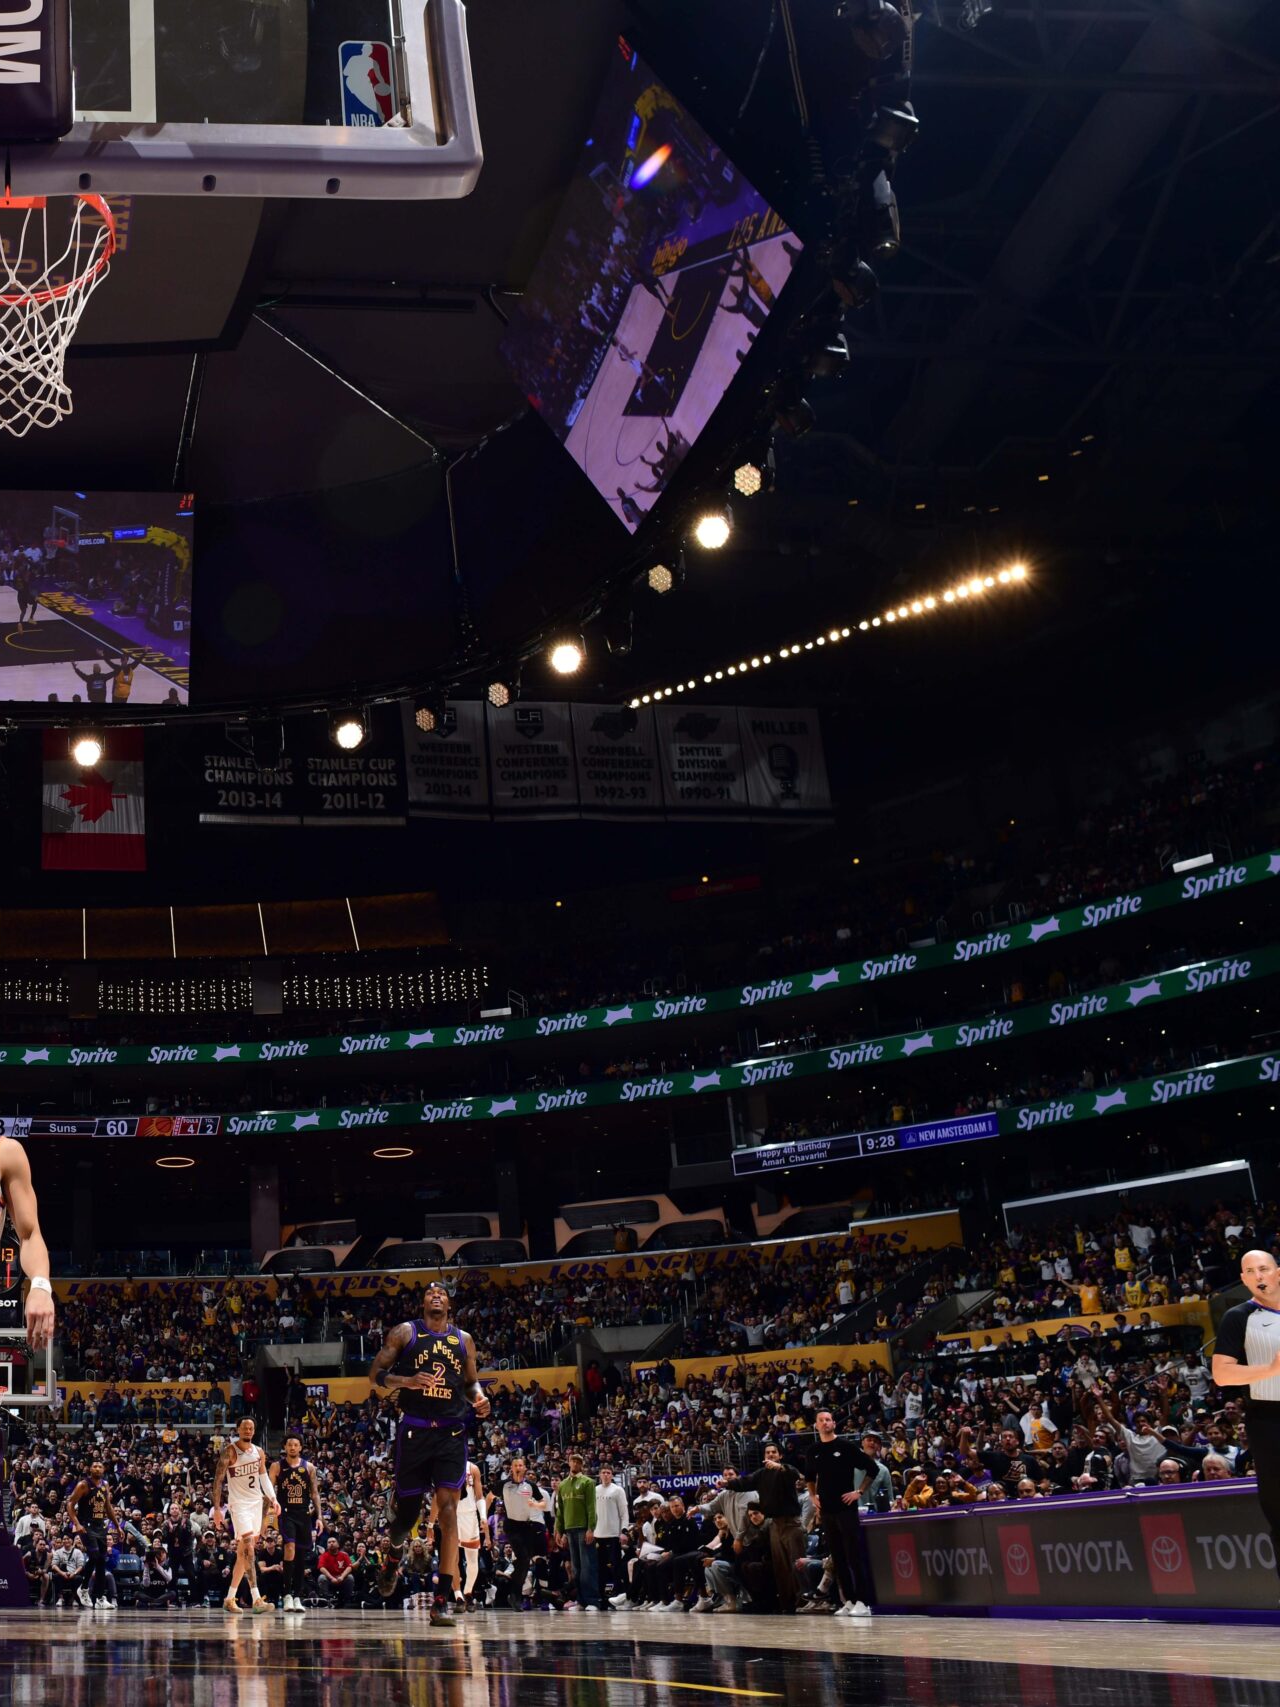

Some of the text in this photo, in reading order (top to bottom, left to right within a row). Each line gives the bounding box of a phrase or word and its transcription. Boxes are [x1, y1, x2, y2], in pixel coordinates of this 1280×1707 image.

[350, 113, 376, 127] NBA
[751, 720, 808, 735] MILLER
[417, 743, 471, 754] WESTERN
[504, 744, 559, 754] WESTERN
[679, 747, 722, 757] SMYTHE
[307, 758, 396, 771] STANLEY CUP
[411, 755, 481, 768] CONFERENCE
[496, 756, 569, 768] CONFERENCE
[583, 758, 654, 769] CONFERENCE
[678, 759, 727, 769] DIVISION
[204, 769, 294, 785] CHAMPIONS
[308, 773, 398, 787] CHAMPIONS
[415, 768, 479, 780] CHAMPIONS
[501, 769, 567, 781] CHAMPIONS
[587, 770, 652, 781] CHAMPIONS
[672, 771, 736, 782] CHAMPIONS
[425, 782, 471, 797] 2013-14
[512, 785, 560, 799] 2011-12
[595, 786, 647, 799] 1992-93
[680, 786, 731, 799] 1990-91
[217, 789, 283, 808] 2013-14
[322, 793, 386, 809] 2011-12
[1183, 867, 1246, 898] Sprite
[1083, 896, 1141, 926] Sprite
[954, 933, 1010, 961] Sprite
[861, 954, 916, 980] Sprite
[1186, 960, 1251, 992] Sprite
[741, 980, 792, 1005] Sprite
[653, 996, 706, 1019] Sprite
[1050, 995, 1107, 1025] Sprite
[536, 1013, 587, 1035] Sprite
[454, 1025, 504, 1045] Sprite
[956, 1019, 1013, 1046] Sprite
[259, 1041, 308, 1060] Sprite
[340, 1034, 390, 1054] Sprite
[68, 1048, 117, 1066] Sprite
[148, 1046, 197, 1064] Sprite
[828, 1043, 883, 1069] Sprite
[741, 1060, 794, 1085] Sprite
[620, 1079, 673, 1101] Sprite
[1151, 1073, 1215, 1103] Sprite
[536, 1090, 587, 1112] Sprite
[338, 1108, 389, 1128] Sprite
[421, 1102, 472, 1122] Sprite
[1017, 1102, 1074, 1130] Sprite
[14, 1123, 30, 1136] 3rd
[49, 1123, 77, 1133] Suns
[106, 1120, 128, 1136] 60
[187, 1125, 194, 1134] 4
[206, 1125, 214, 1134] 2
[227, 1114, 277, 1135] Sprite
[919, 1131, 936, 1142] NEW
[937, 1121, 987, 1139] AMSTERDAM
[756, 1140, 831, 1159] Happy 4th Birthday
[866, 1135, 896, 1150] 9:28
[762, 1151, 827, 1168] Amari Chavarin!
[1, 1248, 14, 1262] 13
[415, 1340, 461, 1375] LOS ANGELES
[432, 1362, 446, 1386] 2
[423, 1388, 453, 1399] LAKERS
[234, 1462, 260, 1477] SUNS
[248, 1475, 255, 1489] 2
[656, 1473, 724, 1489] 17x CHAMPION
[288, 1485, 303, 1497] 20
[922, 1532, 1277, 1576] TOYOTA TOYOTA TOYO
